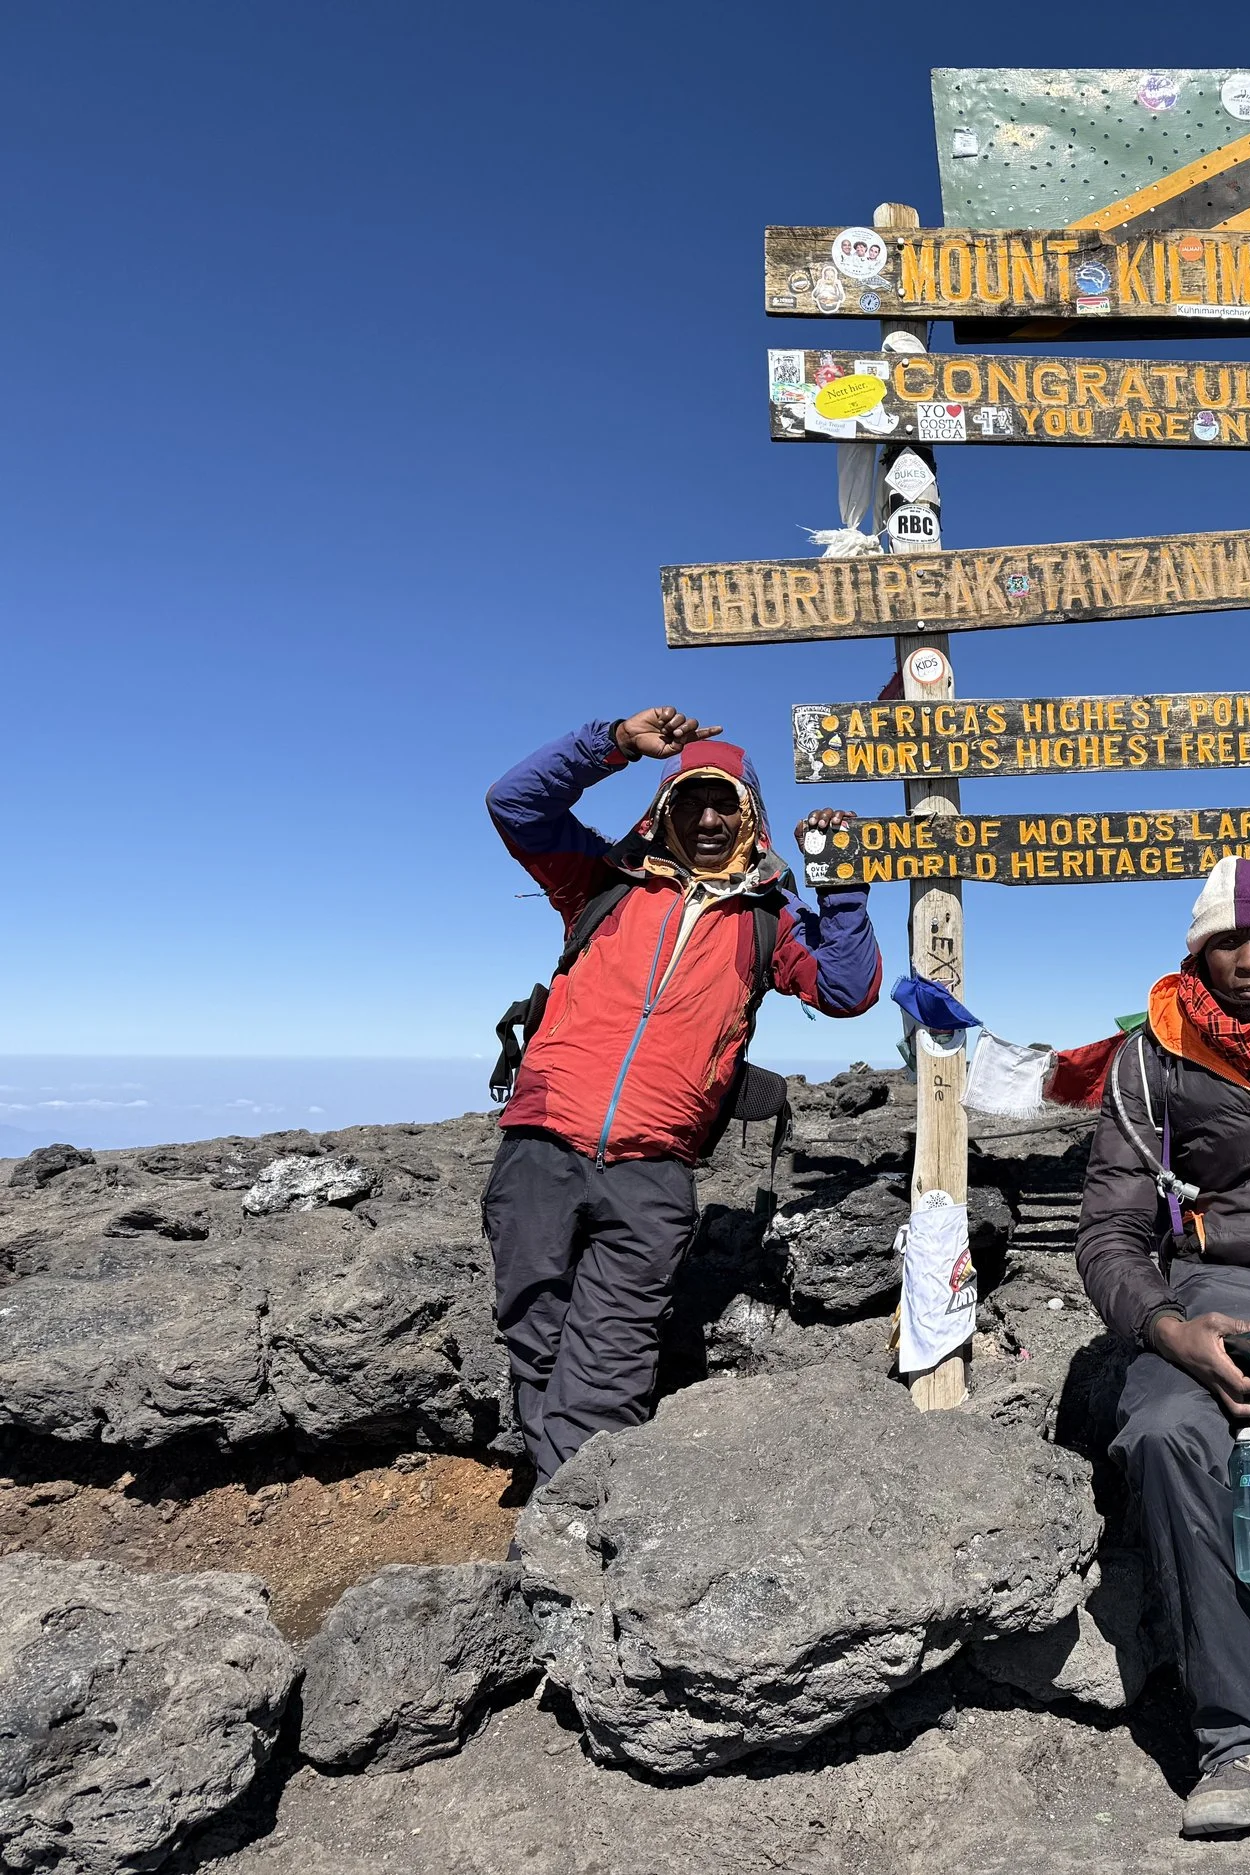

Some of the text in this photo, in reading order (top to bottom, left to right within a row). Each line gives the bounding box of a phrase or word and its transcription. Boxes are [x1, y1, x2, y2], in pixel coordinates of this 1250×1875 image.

[901, 238, 1079, 304] MOUNT
[826, 388, 848, 400] Nett
[919, 404, 946, 418] YO
[919, 418, 964, 430] COSTA
[920, 429, 965, 439] RICA
[1019, 408, 1094, 437] YOU
[1115, 409, 1191, 441] ARE
[894, 469, 926, 479] DUKES
[897, 514, 934, 536] RBC
[680, 562, 856, 633] UHURU
[915, 657, 938, 671] KIDS
[847, 704, 1007, 738] AFRICA'S
[1022, 699, 1172, 732] HIGHEST
[847, 738, 1003, 775] WORLD'S
[1016, 734, 1169, 768] HIGHEST
[861, 821, 938, 850] ONE
[954, 820, 1001, 848] OF
[1011, 845, 1185, 878] HERITAGE
